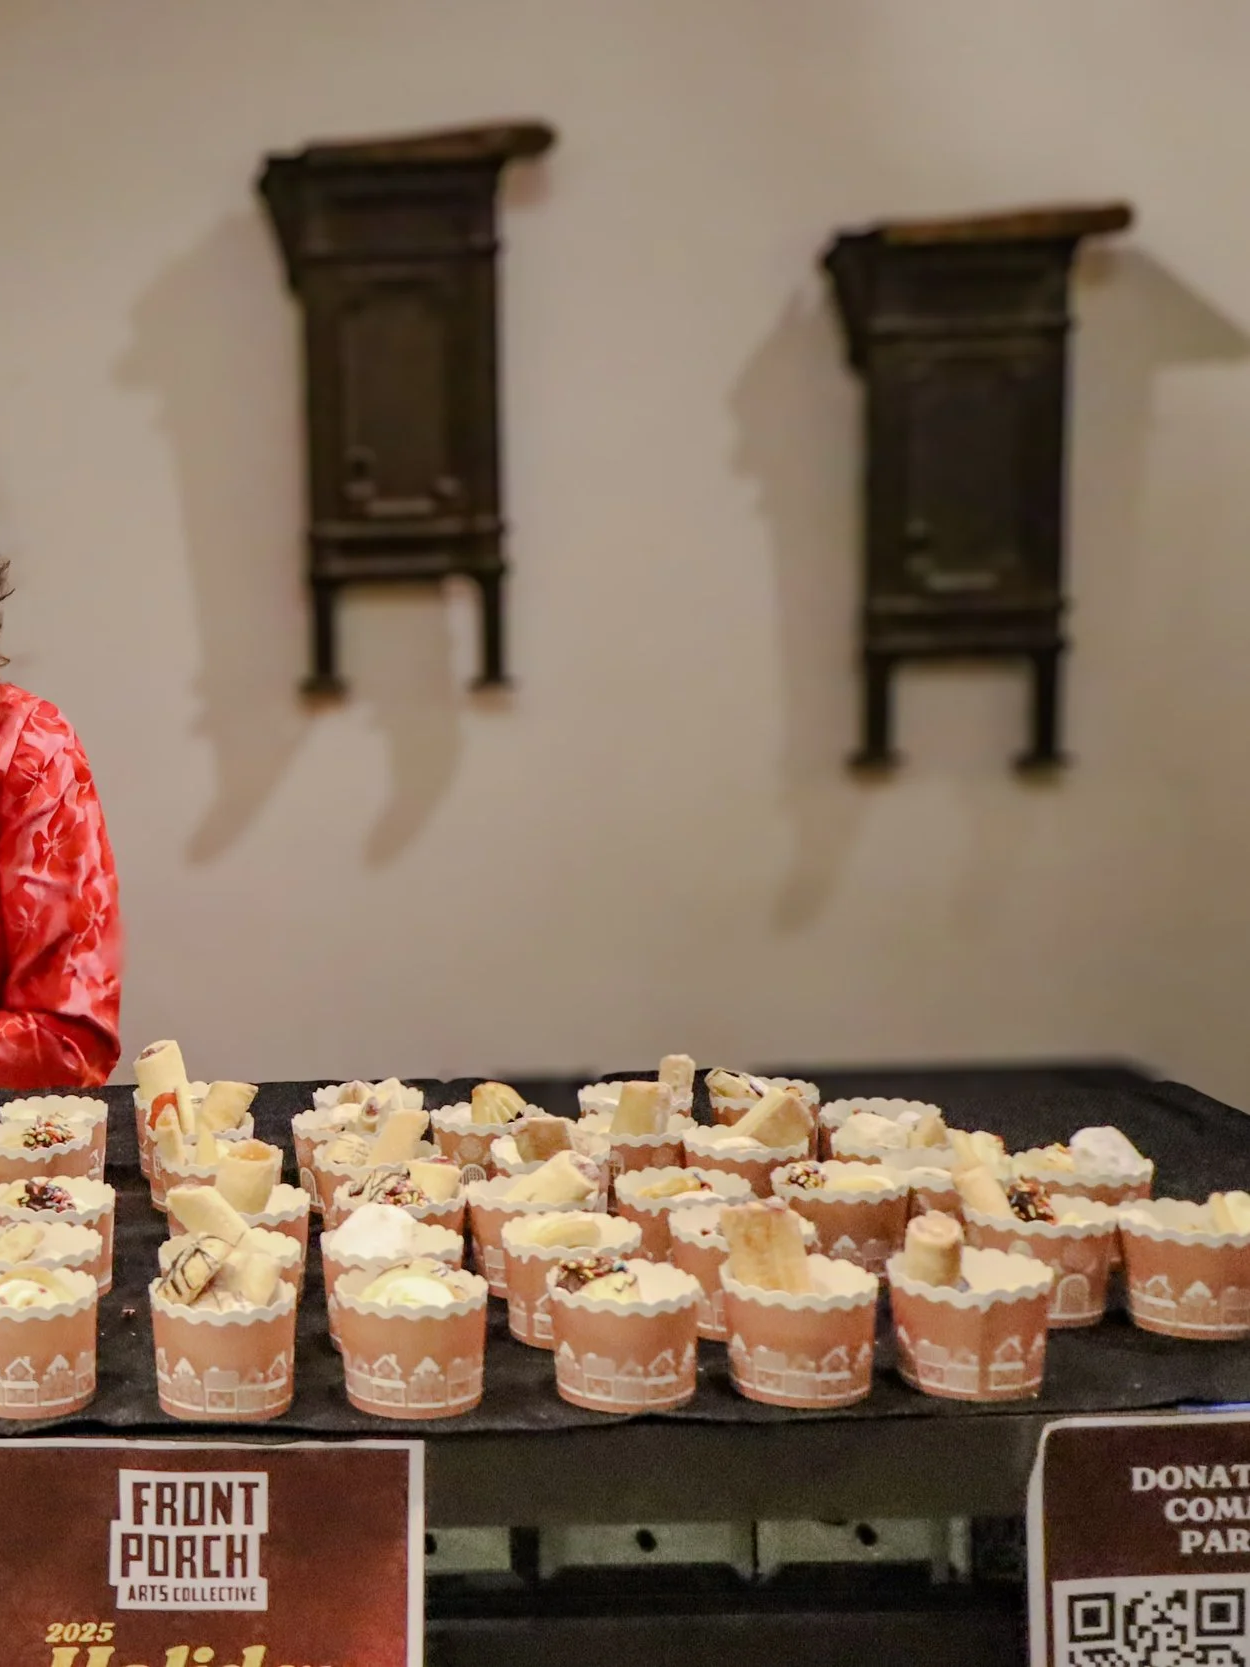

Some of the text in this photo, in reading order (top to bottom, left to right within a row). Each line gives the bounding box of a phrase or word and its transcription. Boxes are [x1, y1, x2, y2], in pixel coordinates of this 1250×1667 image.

[132, 1481, 260, 1526] FRONT
[1164, 1496, 1250, 1522] COM
[121, 1532, 248, 1578] PORCH
[128, 1584, 257, 1602] ARTS COLLECTIVE
[45, 1622, 116, 1643] 2025
